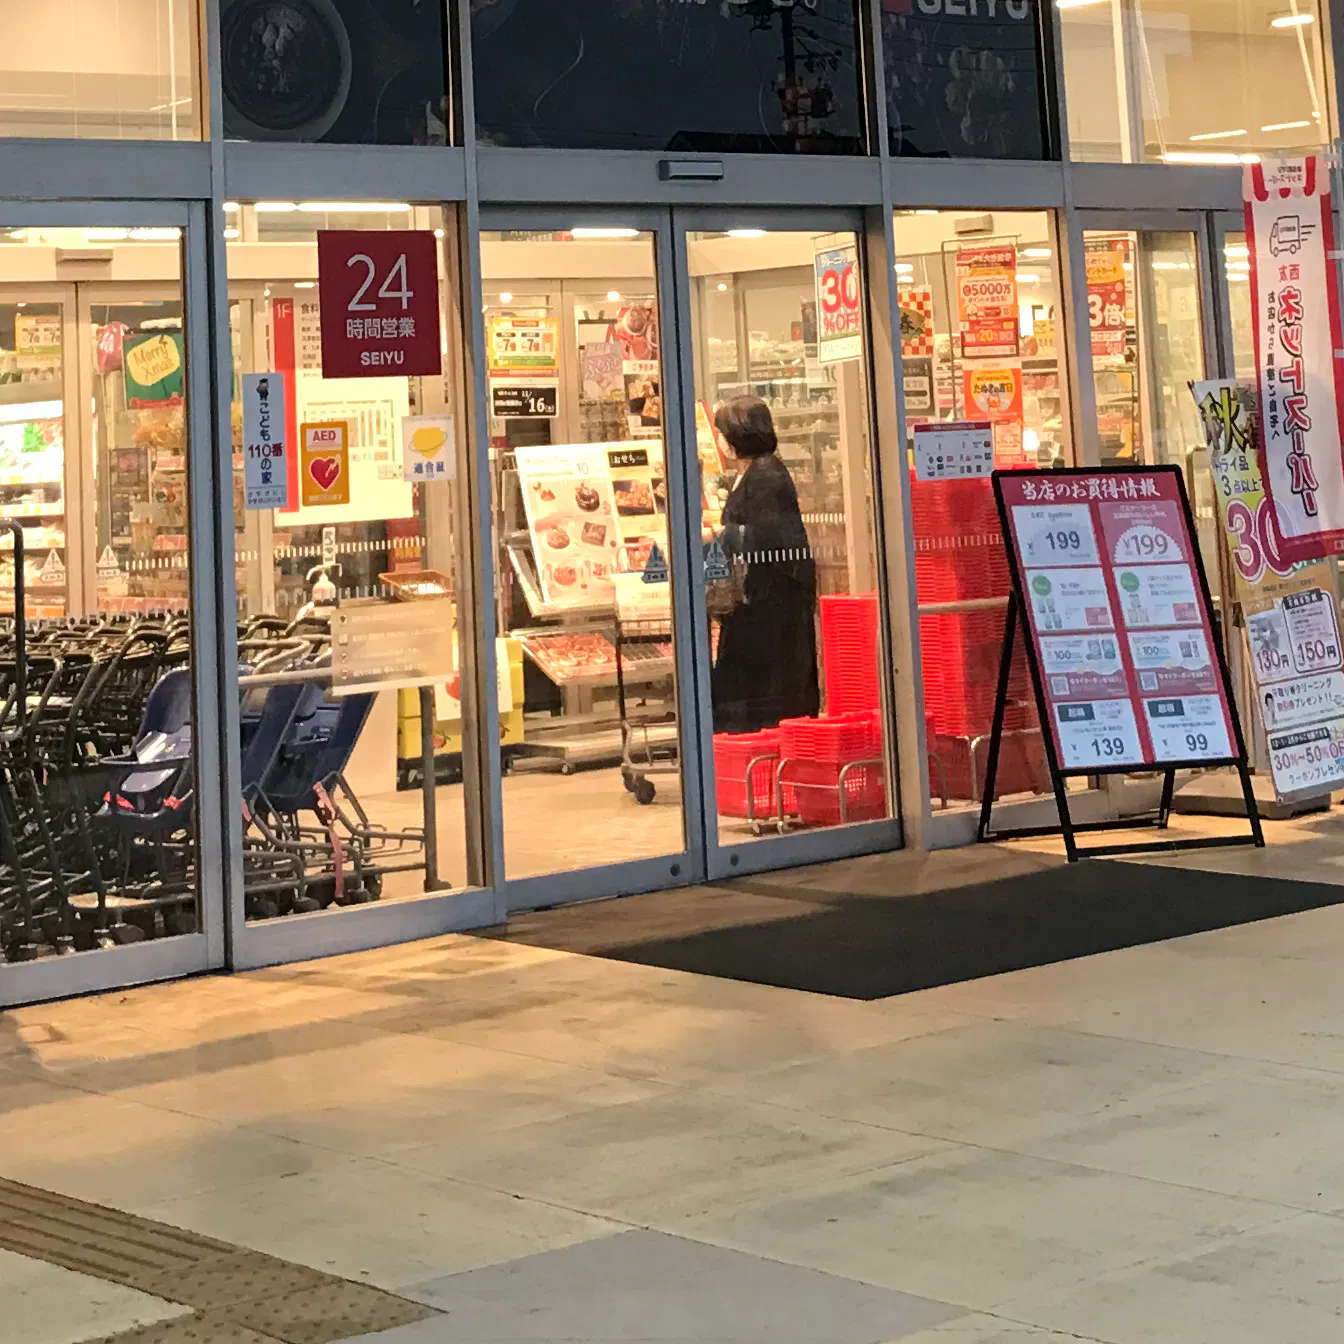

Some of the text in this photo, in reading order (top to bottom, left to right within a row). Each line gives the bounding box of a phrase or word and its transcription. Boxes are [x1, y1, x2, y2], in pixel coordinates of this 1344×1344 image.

[346, 253, 414, 311] 24
[822, 265, 859, 313] 30
[346, 317, 416, 340] 時間営業
[360, 350, 405, 366] SEIYU
[312, 429, 336, 442] AED
[247, 443, 283, 458] 110番
[1022, 477, 1161, 500] 当店のお買得情報
[1045, 530, 1081, 551] 199
[1091, 736, 1125, 757] 139
[1186, 733, 1208, 752] 99
